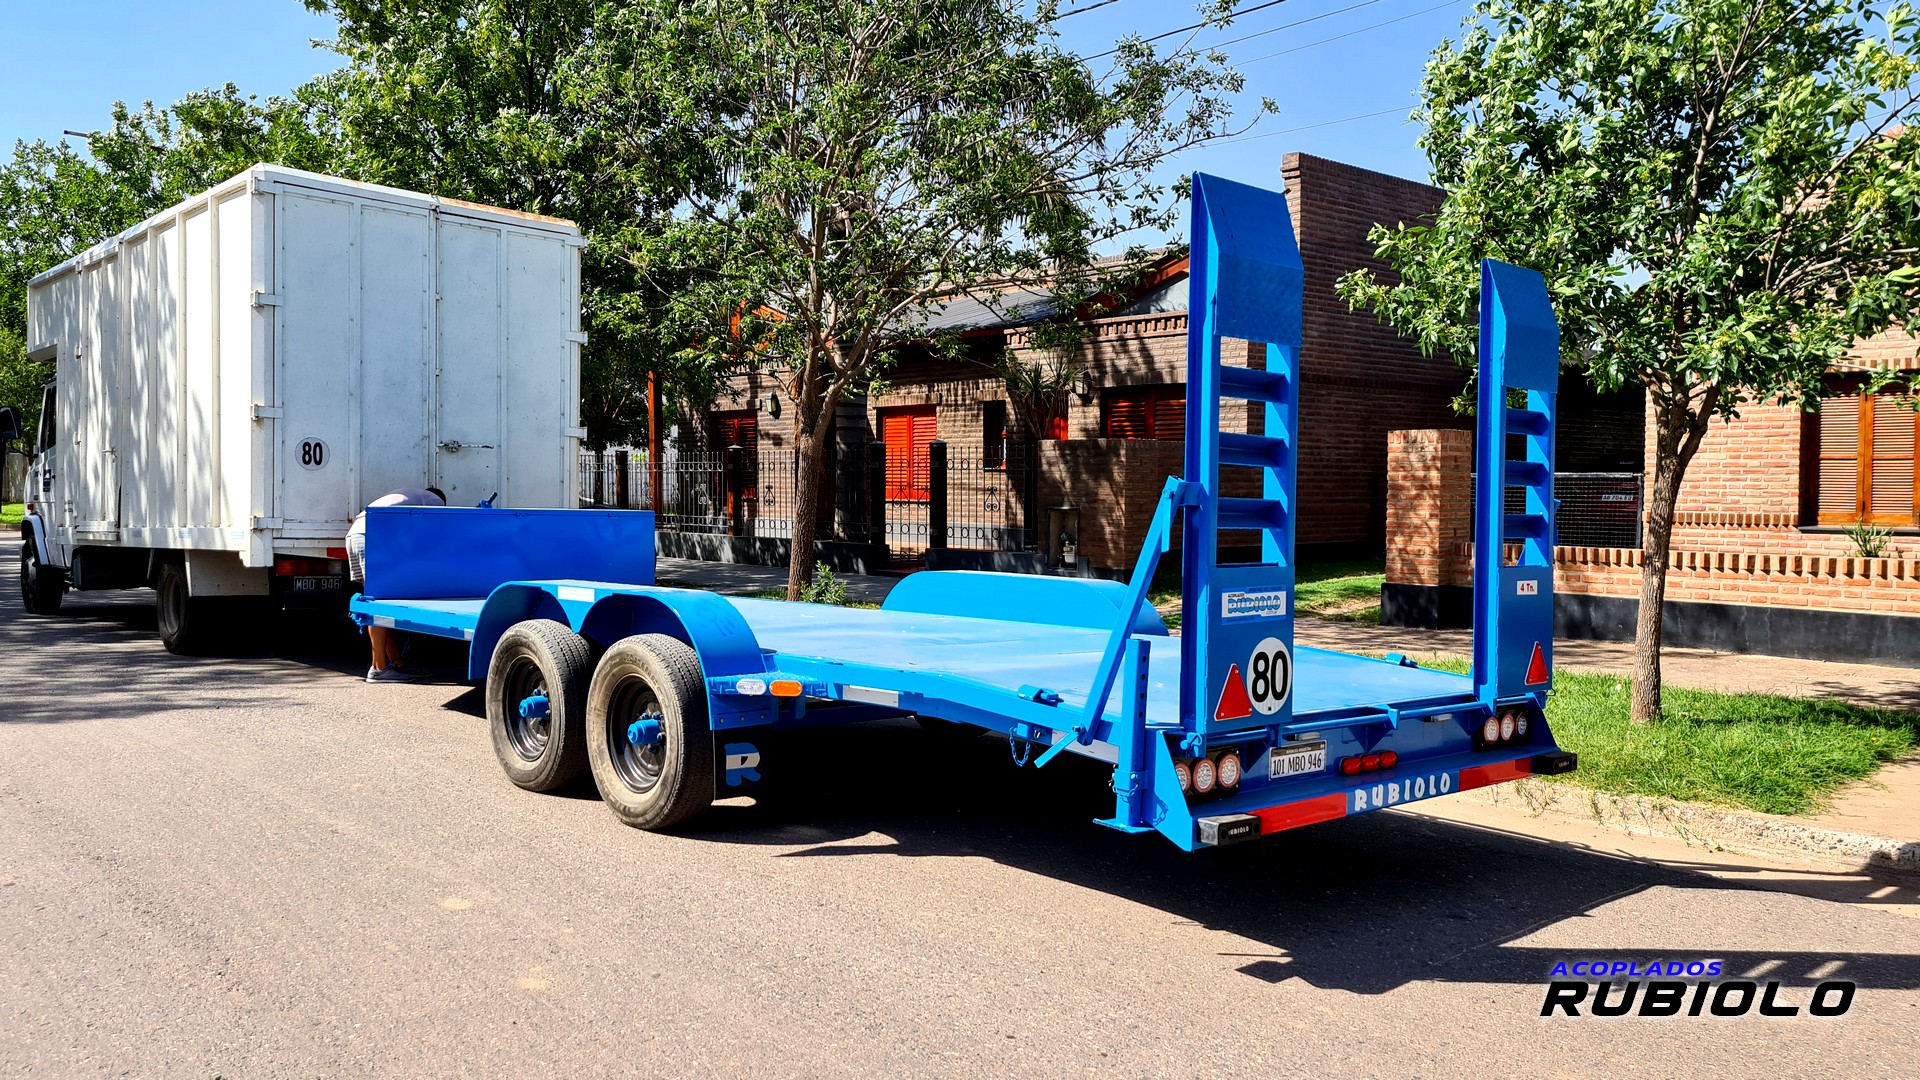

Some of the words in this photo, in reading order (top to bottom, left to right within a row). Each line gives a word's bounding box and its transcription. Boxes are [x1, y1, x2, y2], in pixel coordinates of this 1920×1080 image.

[302, 441, 323, 466] 80
[296, 579, 315, 590] MBO
[321, 579, 340, 590] 946
[1520, 583, 1525, 592] 4
[1227, 595, 1281, 614] RUBIOLO
[1252, 650, 1288, 702] 80
[1272, 758, 1285, 776] 101
[1287, 755, 1306, 774] MBO
[1307, 752, 1322, 770] 946
[1354, 772, 1451, 811] RUBIOLO
